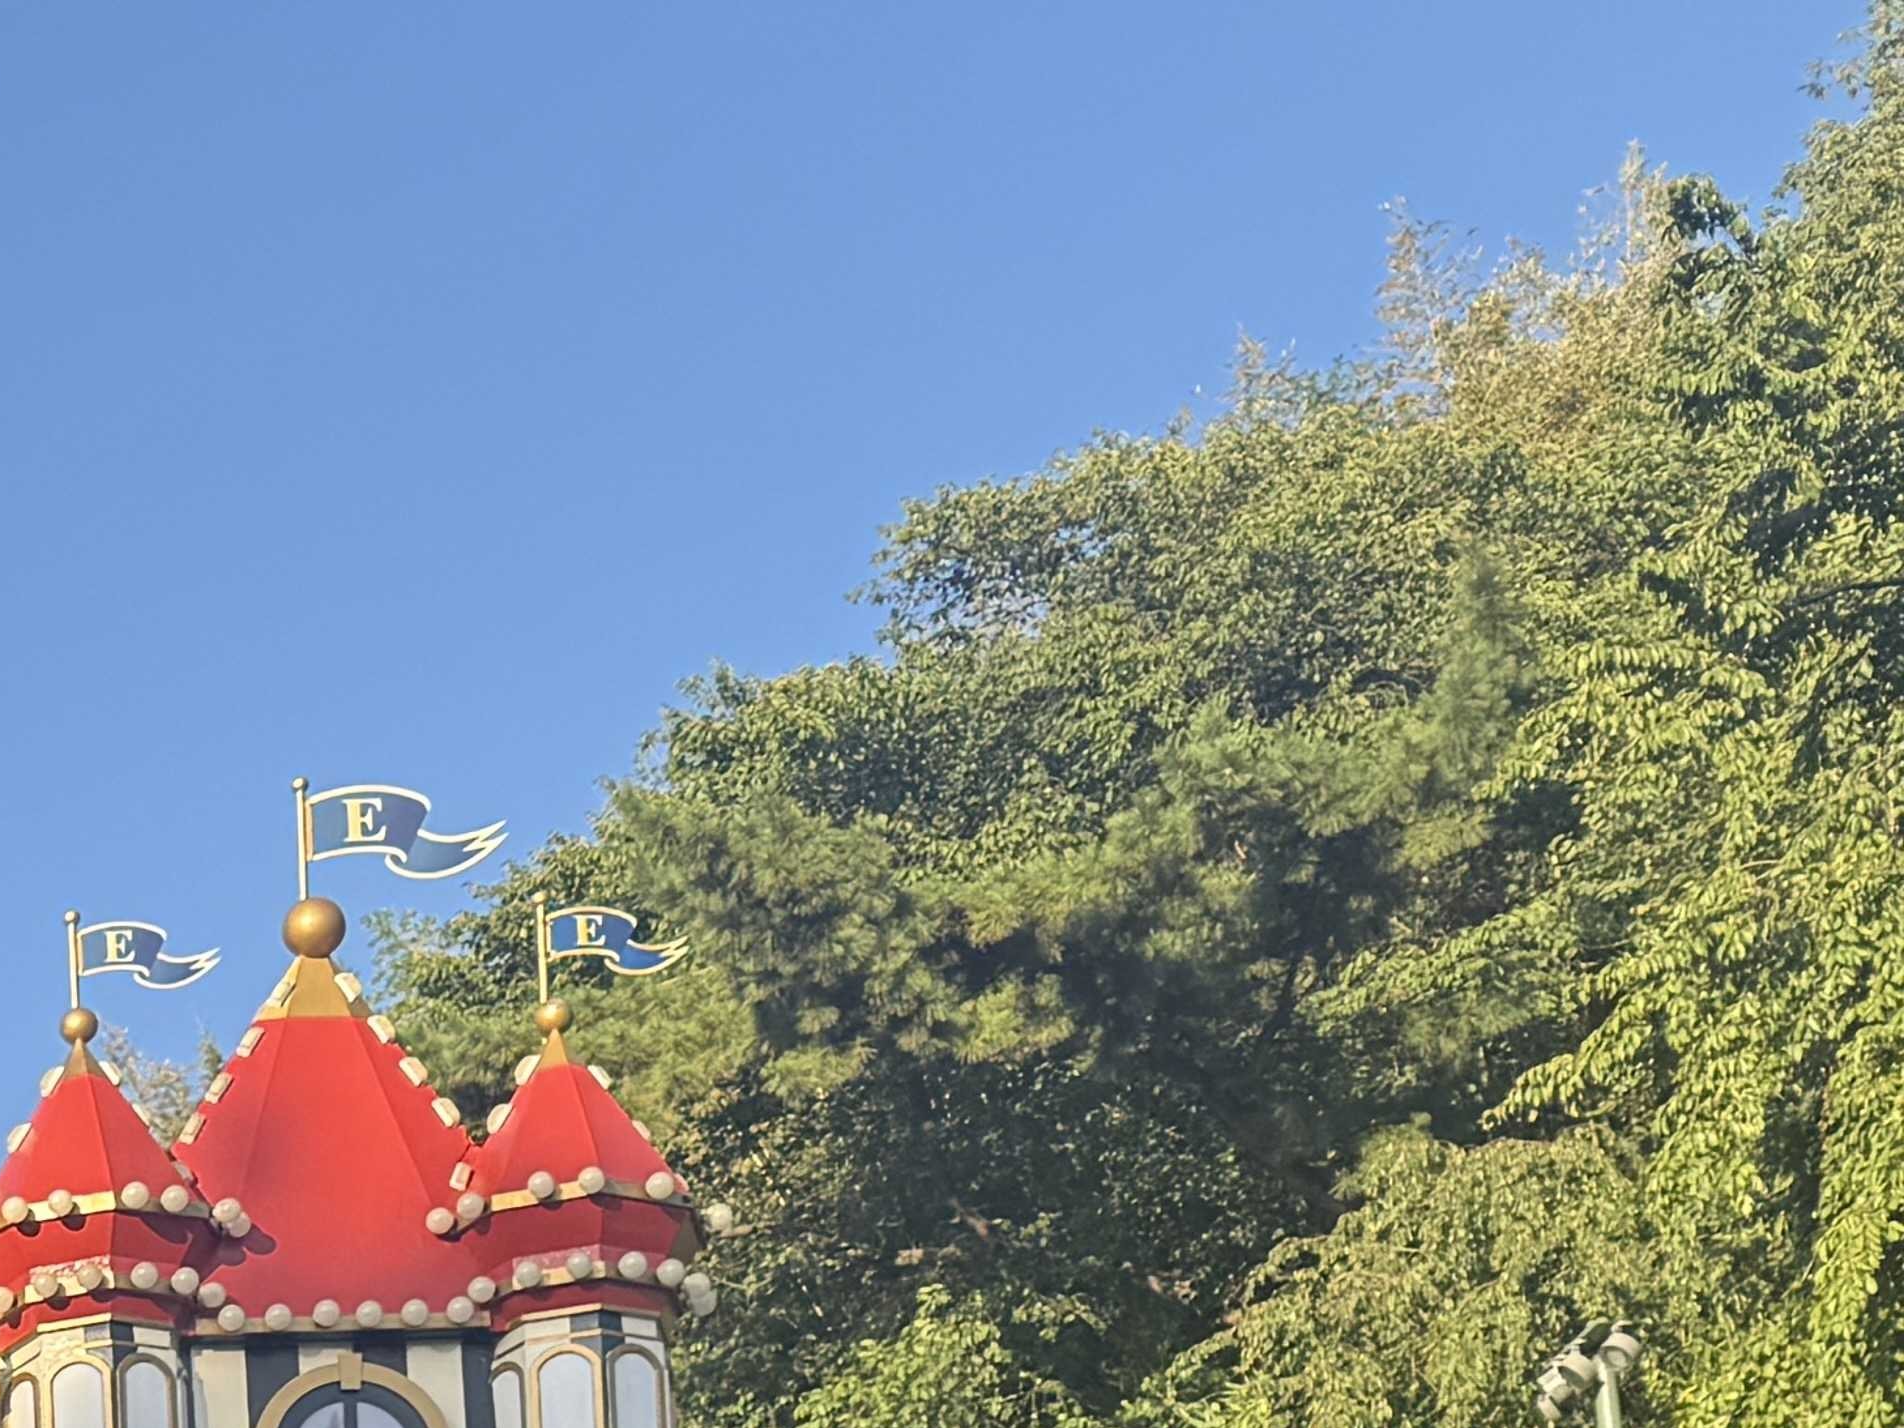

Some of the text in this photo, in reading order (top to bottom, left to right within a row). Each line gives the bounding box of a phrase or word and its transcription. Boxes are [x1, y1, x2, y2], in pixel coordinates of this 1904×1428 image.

[342, 797, 387, 843] E
[103, 930, 135, 963] E
[575, 914, 607, 947] E
